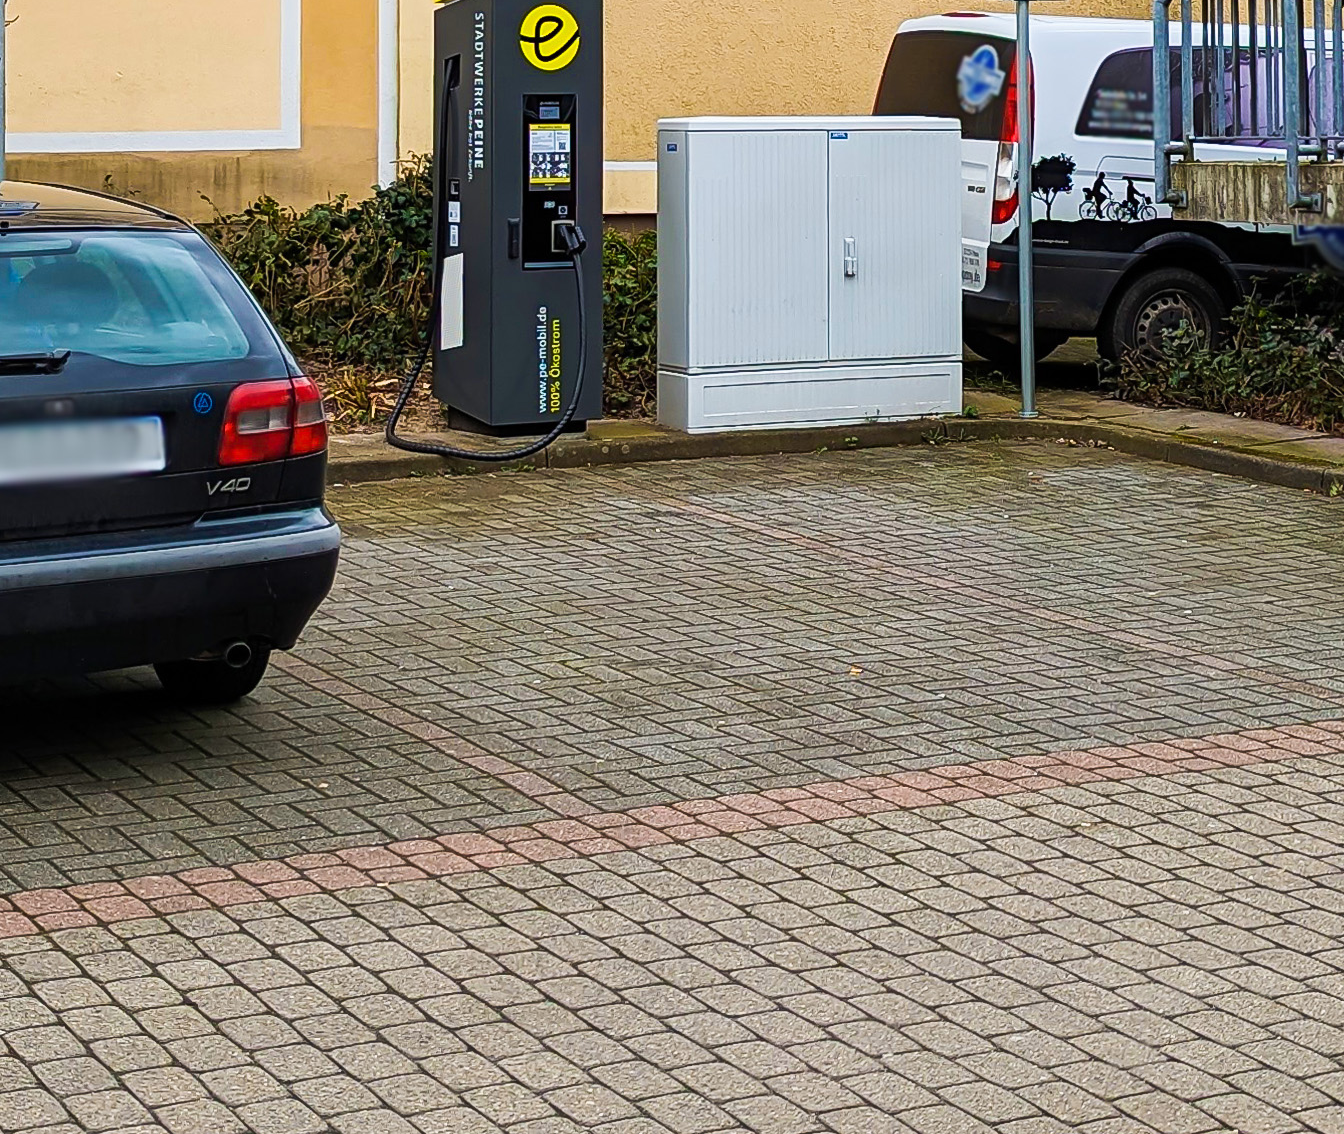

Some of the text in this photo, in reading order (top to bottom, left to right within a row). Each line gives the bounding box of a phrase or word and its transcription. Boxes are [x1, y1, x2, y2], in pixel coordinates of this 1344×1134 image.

[474, 12, 484, 169] STADTWERKE PEINE
[549, 319, 560, 413] 100% Ökostrom
[207, 477, 251, 496] V40
